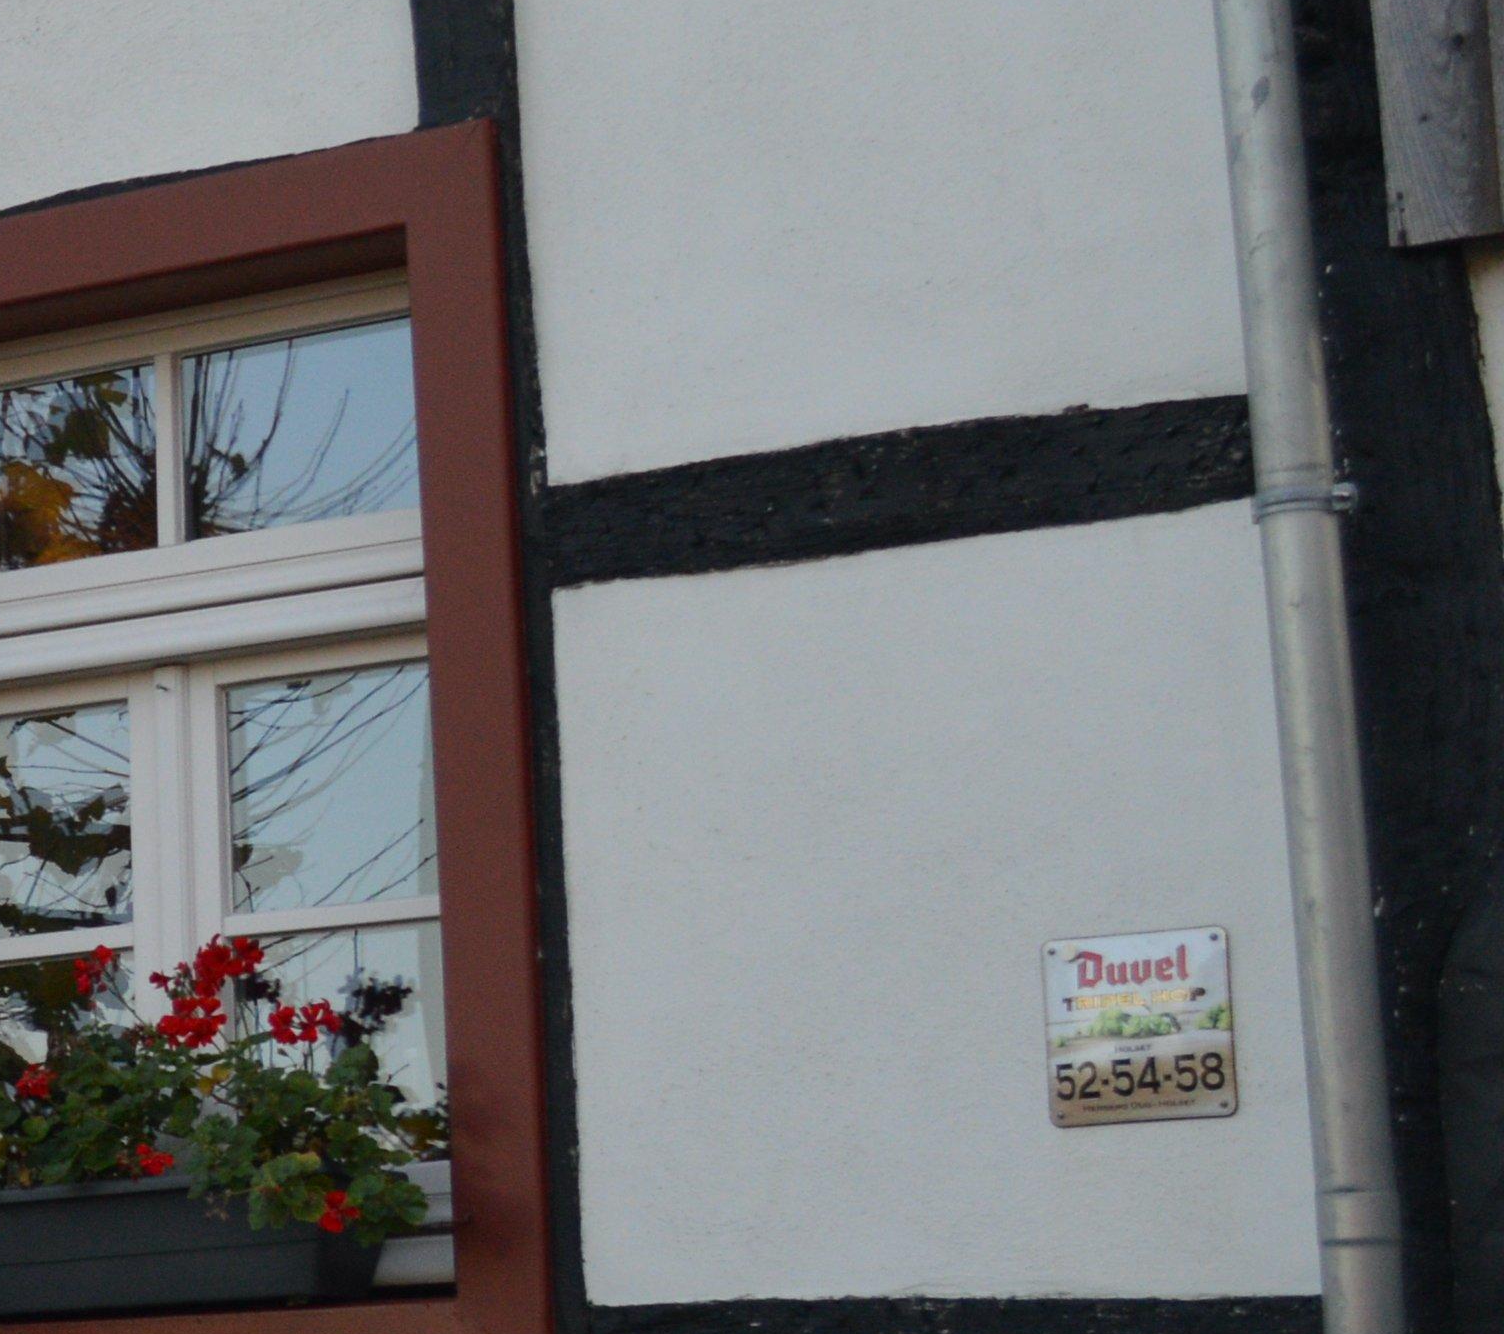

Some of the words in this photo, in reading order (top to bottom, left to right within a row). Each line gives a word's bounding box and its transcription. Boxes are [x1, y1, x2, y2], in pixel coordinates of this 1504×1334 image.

[1068, 943, 1190, 989] Duvel
[1062, 992, 1148, 1013] TRIPEL
[1151, 986, 1207, 1005] HOP
